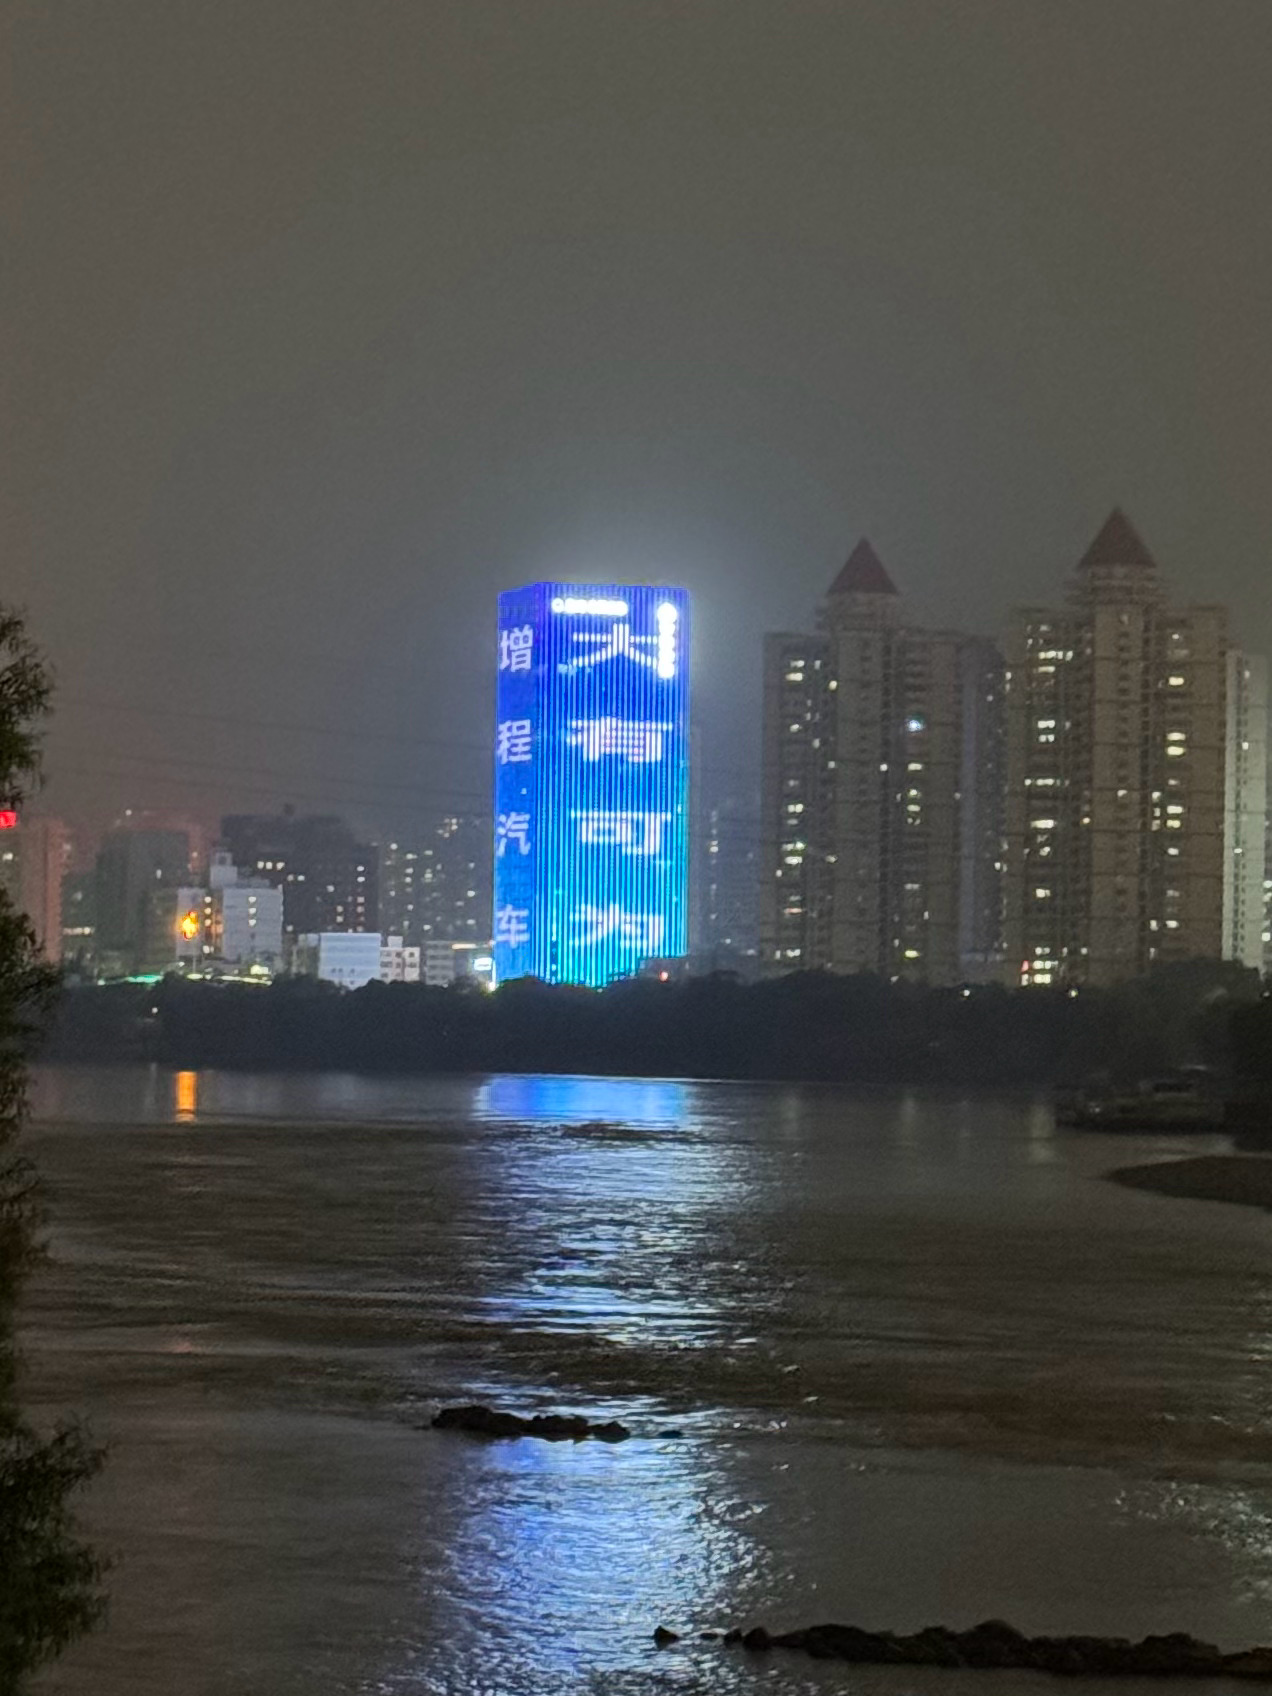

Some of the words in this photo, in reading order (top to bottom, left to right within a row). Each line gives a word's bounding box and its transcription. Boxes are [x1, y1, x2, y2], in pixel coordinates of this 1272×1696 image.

[497, 624, 534, 949] 增程汽车
[566, 623, 672, 950] 大有可为
